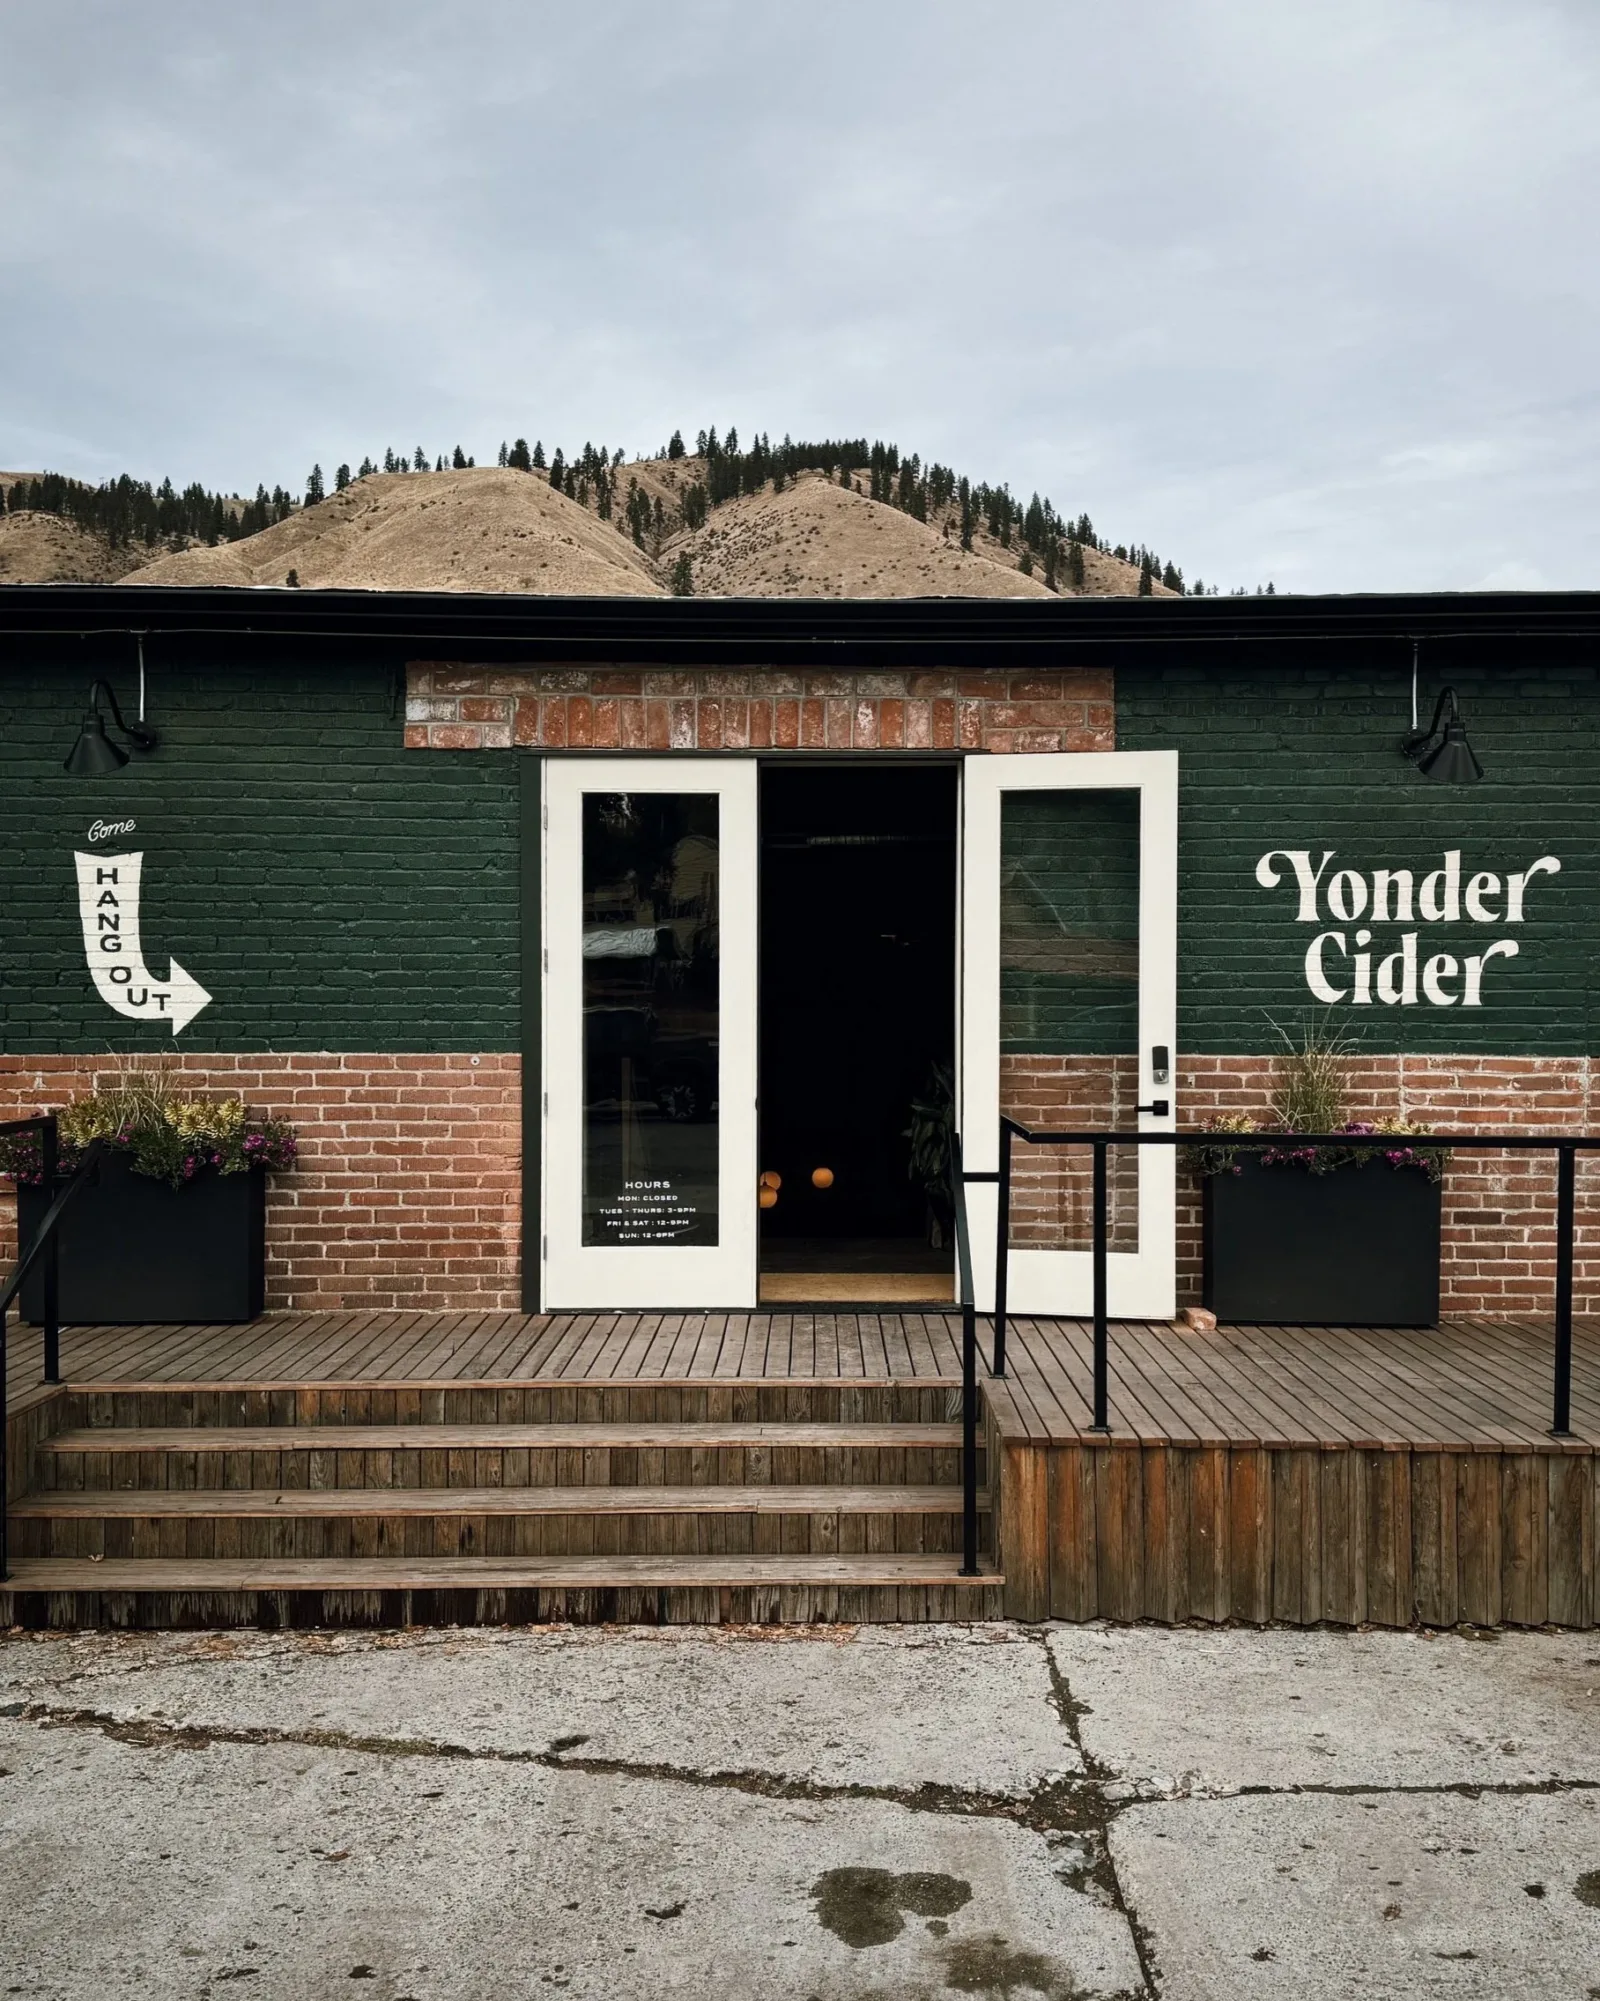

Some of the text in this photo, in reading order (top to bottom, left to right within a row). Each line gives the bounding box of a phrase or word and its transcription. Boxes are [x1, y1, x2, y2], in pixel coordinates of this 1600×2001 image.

[88, 819, 136, 842] Come
[1255, 849, 1561, 922] Yonder
[96, 867, 171, 1012] HANG OUT
[1305, 929, 1519, 1006] Cider
[625, 1181, 671, 1189] HOURS
